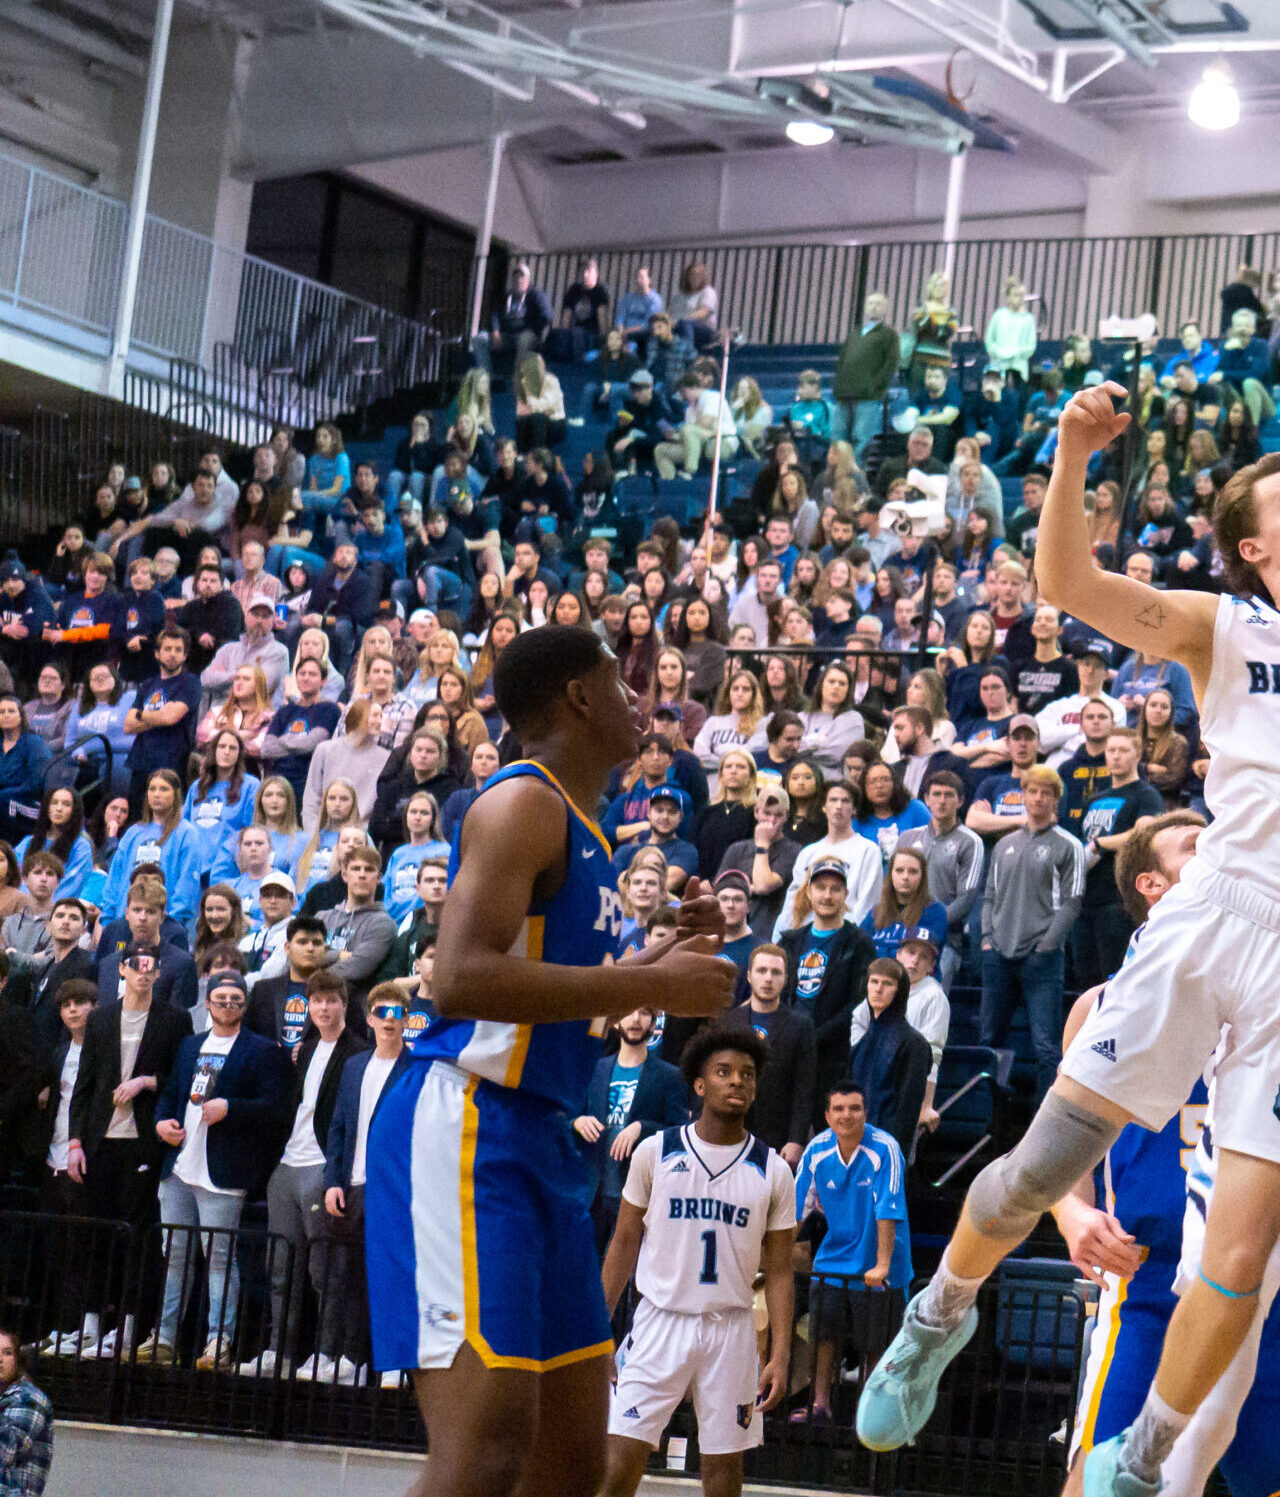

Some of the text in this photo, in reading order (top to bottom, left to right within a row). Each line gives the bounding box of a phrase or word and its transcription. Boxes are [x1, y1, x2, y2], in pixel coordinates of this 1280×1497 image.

[917, 928, 930, 941] B
[669, 1197, 751, 1228] BRUINS
[699, 1229, 718, 1285] 1
